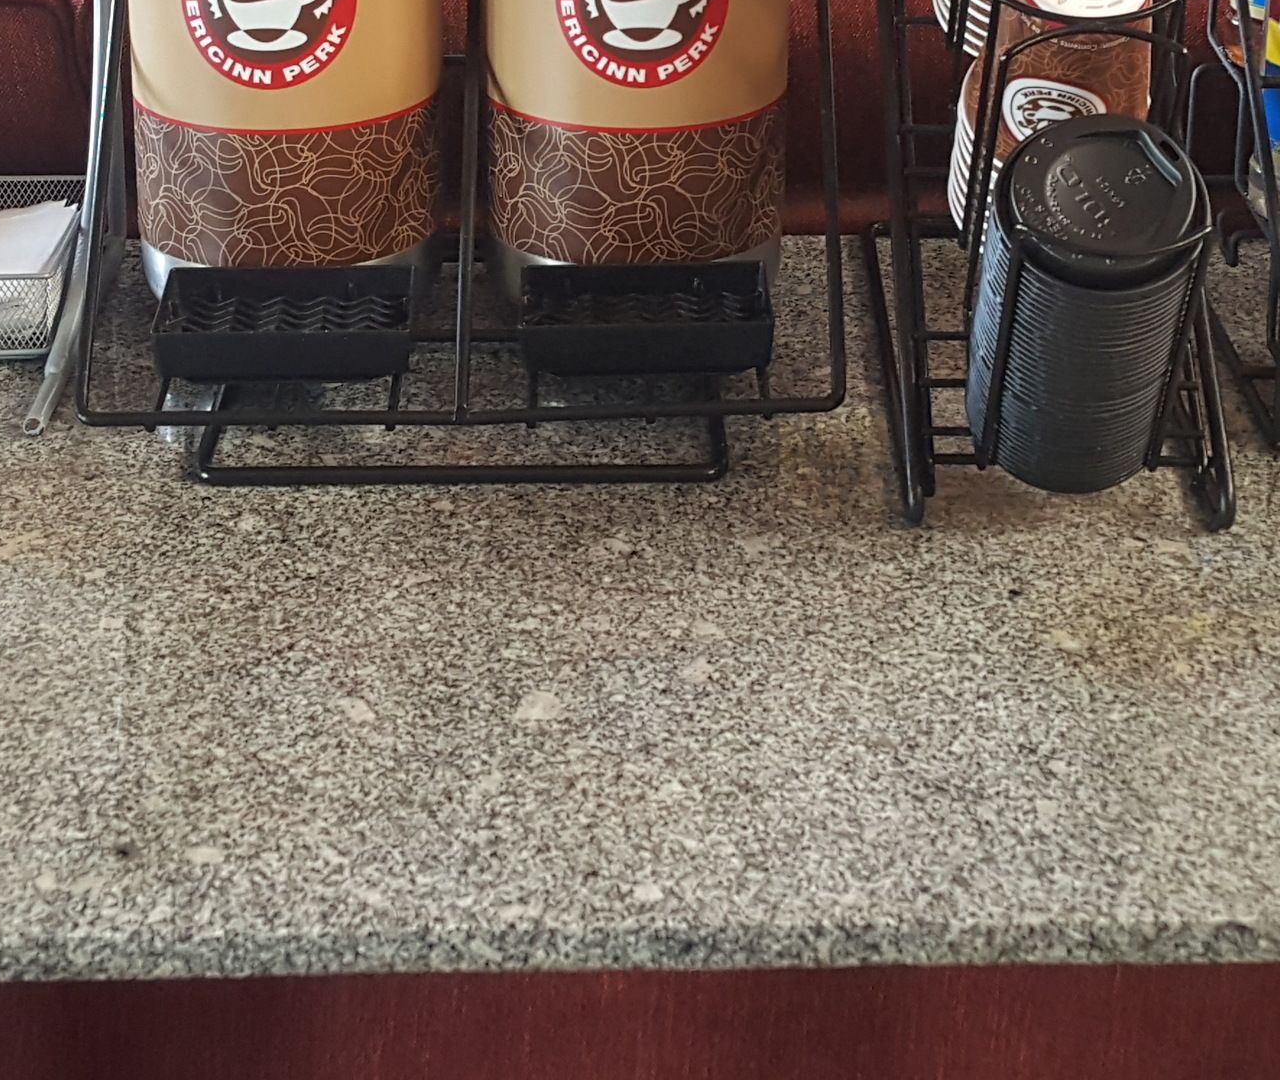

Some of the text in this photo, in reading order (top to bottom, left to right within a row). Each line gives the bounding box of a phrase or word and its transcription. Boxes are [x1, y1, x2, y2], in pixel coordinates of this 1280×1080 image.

[283, 23, 347, 83] PERK
[656, 23, 720, 82] PERK
[1020, 90, 1052, 98] PERK
